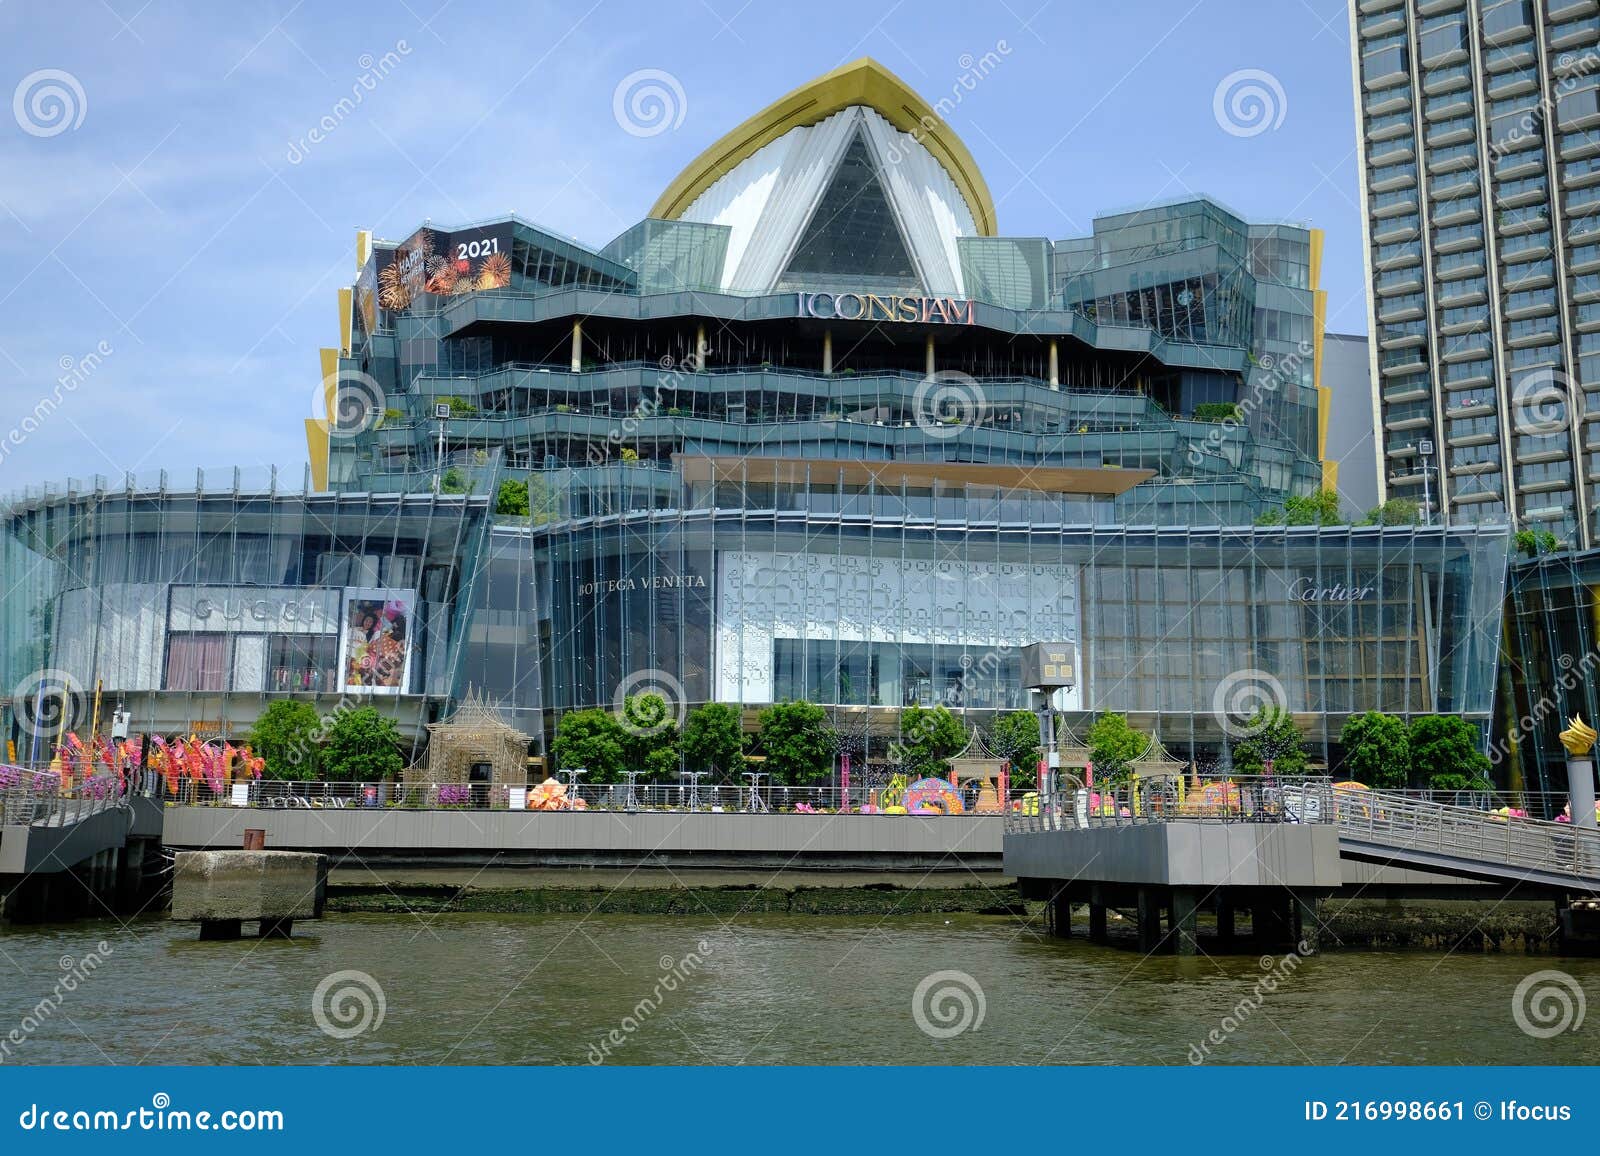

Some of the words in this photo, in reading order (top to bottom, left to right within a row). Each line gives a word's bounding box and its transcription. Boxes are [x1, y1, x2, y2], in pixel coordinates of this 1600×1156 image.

[400, 245, 424, 276] HAPPY
[457, 237, 498, 260] 2021
[798, 292, 975, 325] ICONSIAM
[579, 579, 636, 596] BOTTEGA
[640, 575, 706, 589] VENETA
[1288, 576, 1374, 601] Cartier
[195, 600, 315, 622] GUCCI
